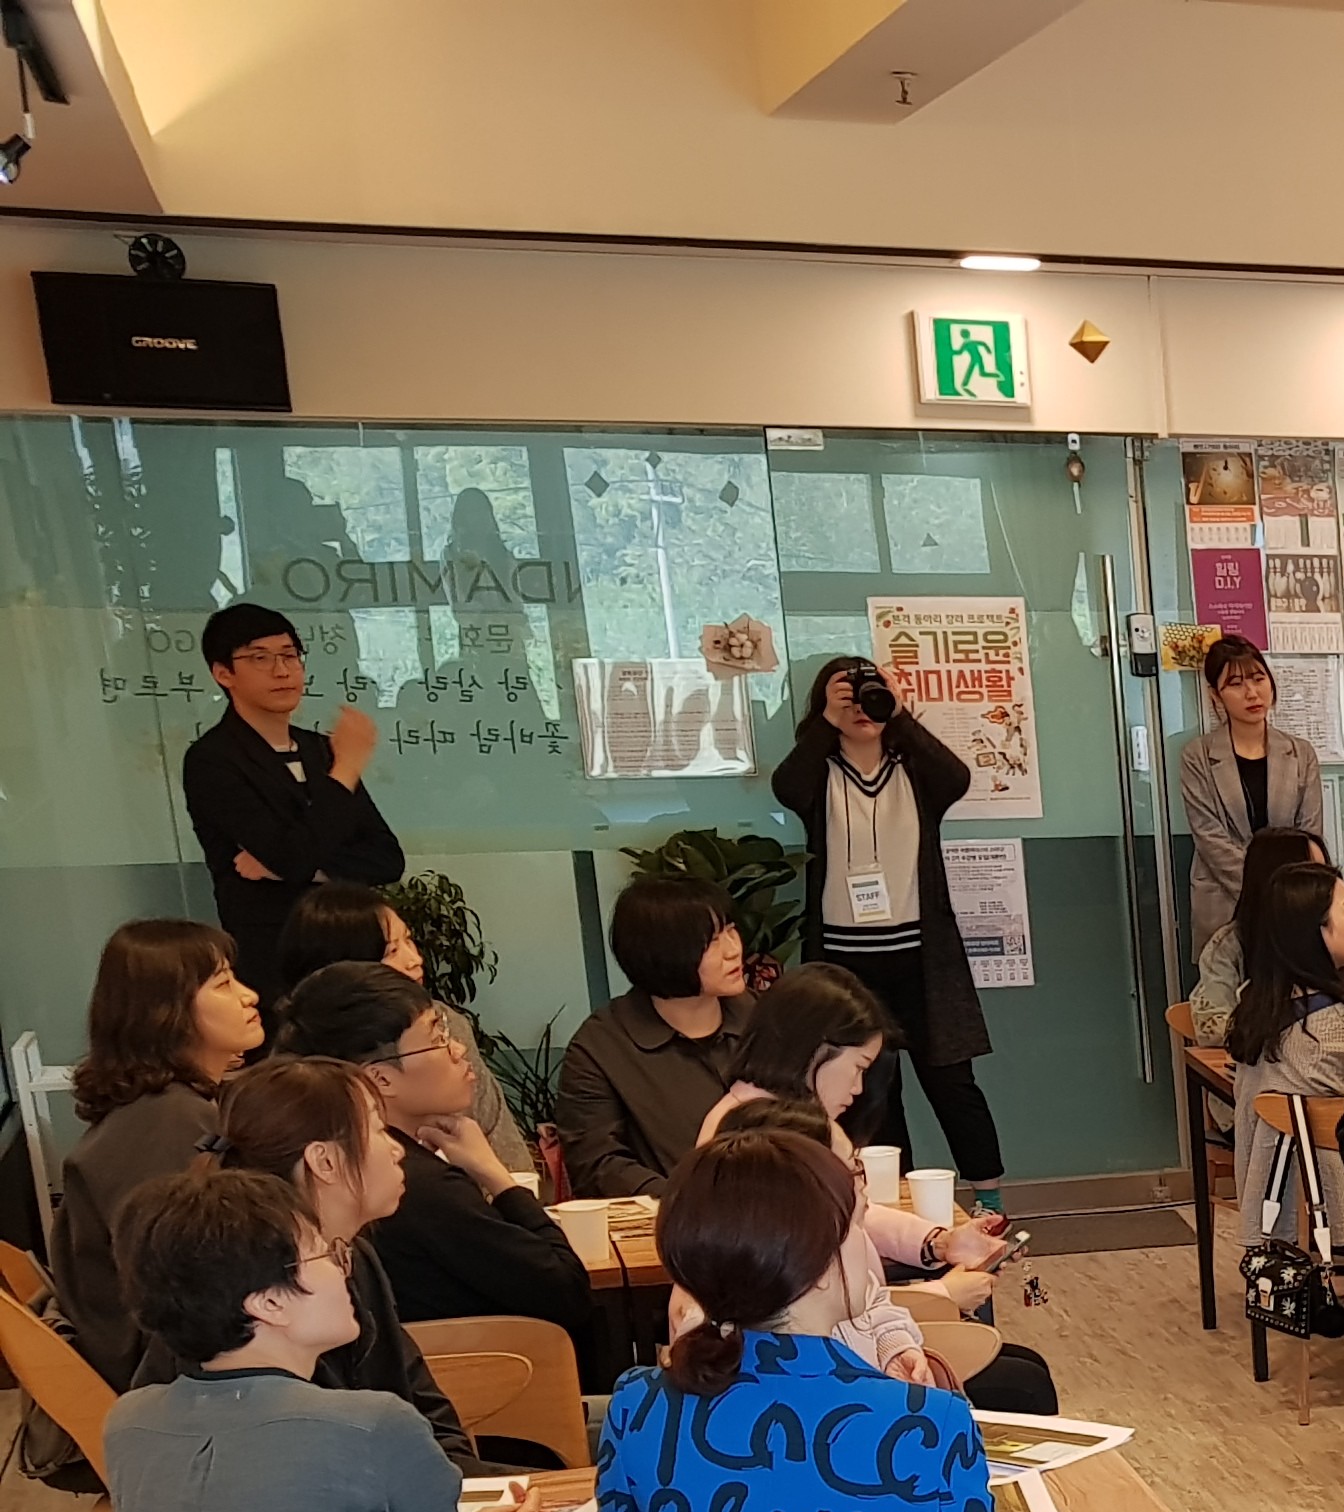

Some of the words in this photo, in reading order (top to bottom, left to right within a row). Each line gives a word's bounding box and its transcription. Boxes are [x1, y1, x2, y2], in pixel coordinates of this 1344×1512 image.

[131, 335, 198, 352] GROOVE
[914, 614, 942, 625] 동아리
[967, 614, 1004, 624] 프로젝트
[889, 630, 1012, 668] 슬기로운
[892, 668, 1015, 703] 취미생활
[855, 891, 880, 902] STAFF
